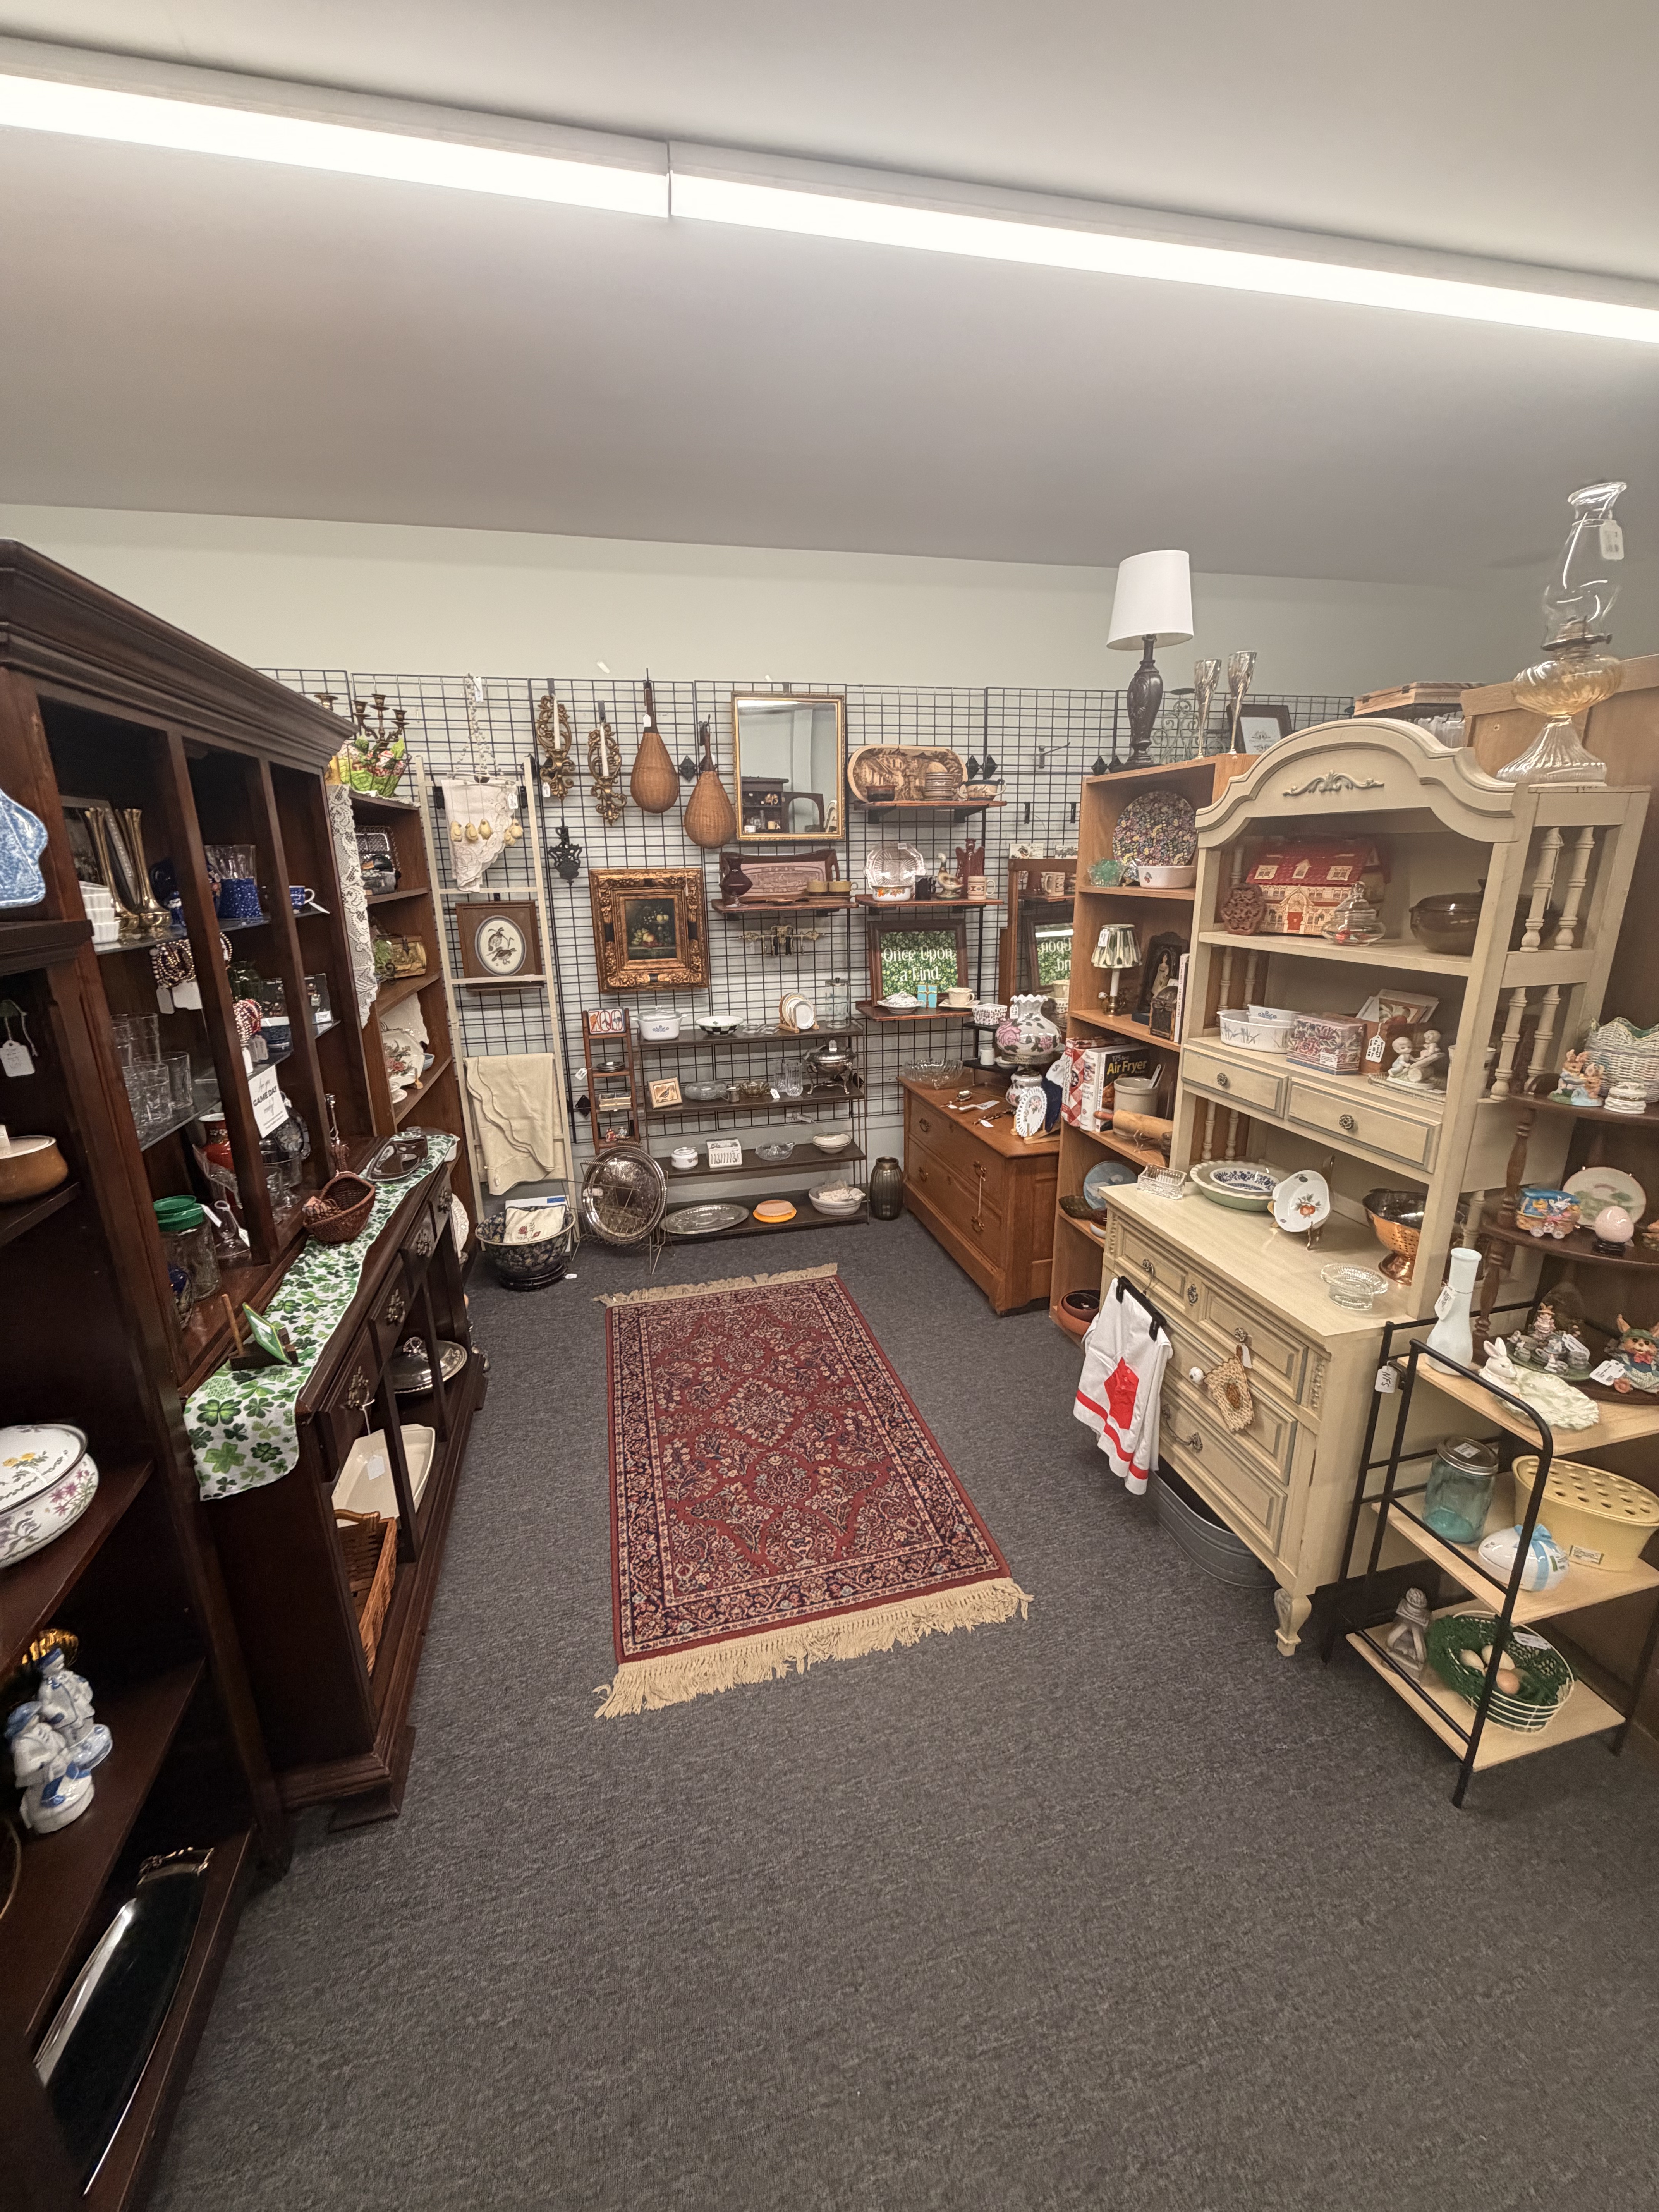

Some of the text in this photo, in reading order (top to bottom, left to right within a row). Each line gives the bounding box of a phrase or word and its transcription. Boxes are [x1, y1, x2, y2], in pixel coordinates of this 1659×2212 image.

[884, 946, 953, 963] Once Upon
[900, 966, 941, 981] a Find
[589, 1010, 623, 1032] ZOO
[1107, 1060, 1147, 1075] Air Fryer
[253, 1085, 277, 1106] GAME DAY
[1381, 1371, 1392, 1387] NFS
